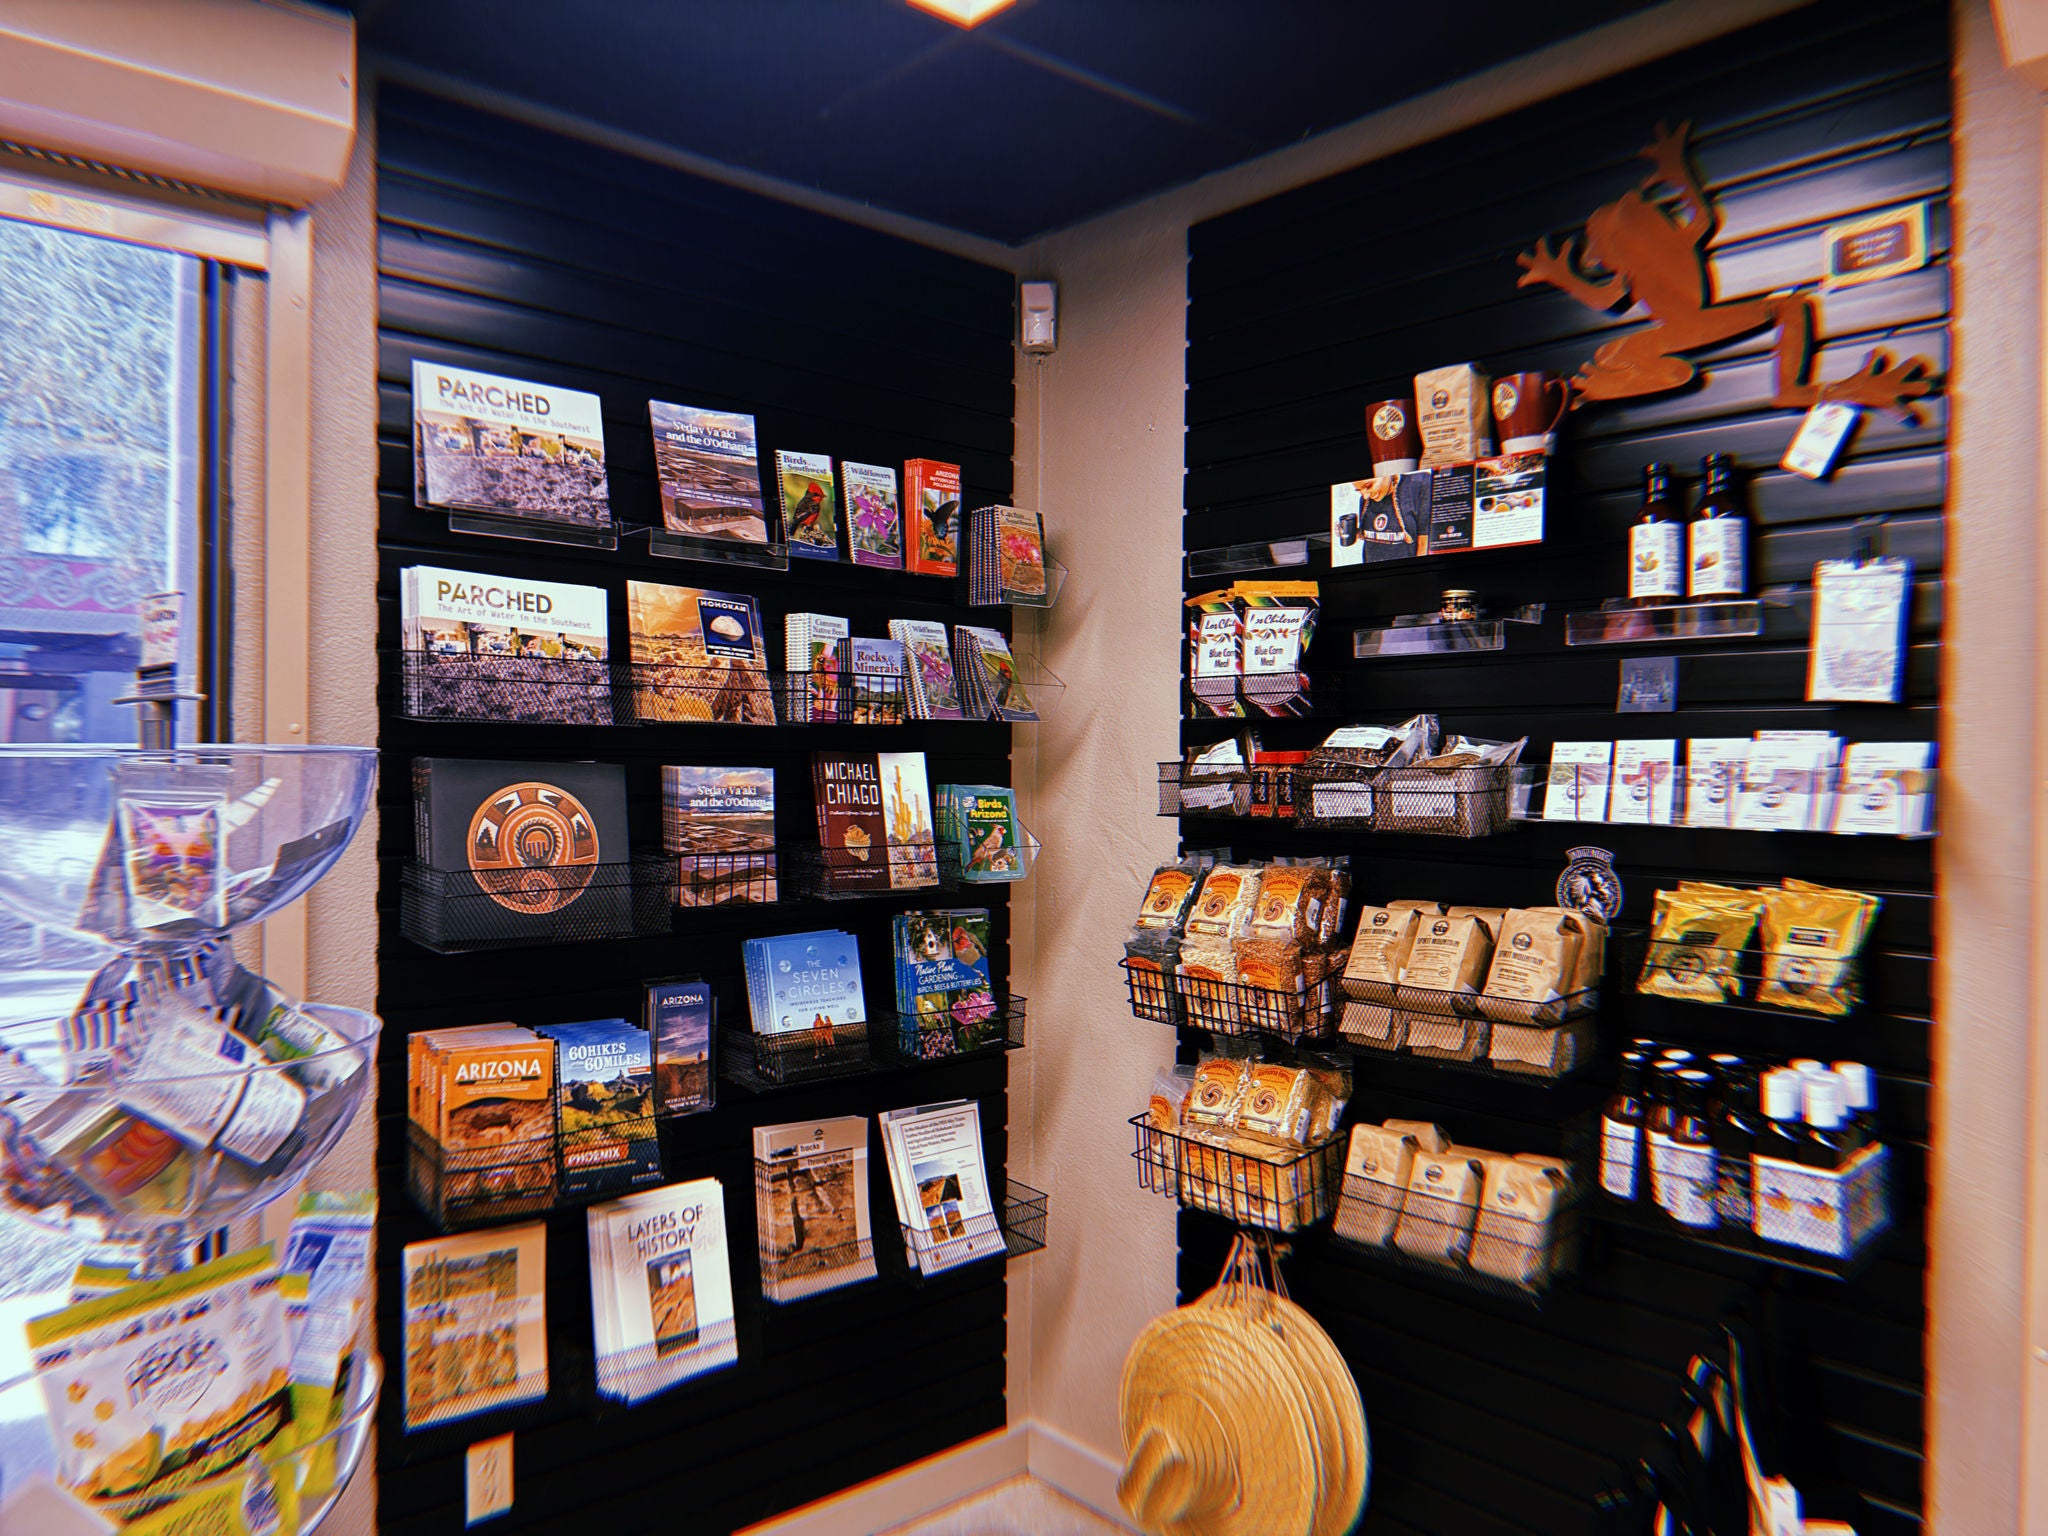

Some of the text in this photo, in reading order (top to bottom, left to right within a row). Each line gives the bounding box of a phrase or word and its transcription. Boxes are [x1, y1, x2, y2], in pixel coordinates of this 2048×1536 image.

[437, 376, 550, 416] PARCHED
[492, 409, 514, 420] Water
[550, 418, 591, 433] Southwest
[666, 432, 748, 452] and the O'Odham
[783, 454, 807, 465] Birds
[788, 464, 827, 474] Southwest
[850, 466, 892, 480] Wildflowers
[437, 580, 552, 614] PARCHED
[700, 600, 747, 612] HOHOKAM
[438, 604, 592, 630] The Art of Water in the Southwest
[1264, 613, 1300, 624] Chileros
[1205, 618, 1236, 630] Los Chil
[857, 650, 887, 662] Rocks
[1209, 648, 1222, 658] Blue
[1254, 646, 1284, 656] Blue Corn
[1214, 658, 1230, 668] Meal
[1260, 656, 1275, 666] Meal
[854, 662, 900, 674] Minerals
[824, 762, 877, 781] MICHAEL
[826, 784, 880, 806] CHIAGO
[690, 797, 766, 808] and the O'Odham
[978, 798, 1003, 808] Birds
[970, 809, 1008, 819] Arizona
[806, 960, 822, 968] THE
[914, 961, 955, 976] Native Plant
[792, 968, 839, 984] SEVEN
[919, 972, 958, 984] GARDENING
[788, 981, 845, 998] CIRCLES
[950, 978, 982, 990] BUTTERFLIES
[662, 994, 704, 1006] ARIZONA
[568, 1042, 627, 1061] 60 HIKES
[585, 1052, 642, 1072] 60 MILES
[455, 1059, 542, 1082] ARIZONA
[800, 1143, 820, 1152] Tracks
[568, 1148, 620, 1166] PHOENIX
[807, 1156, 830, 1166] Through
[627, 1204, 704, 1243] LAYERS OF
[636, 1225, 696, 1260] HISTORY
